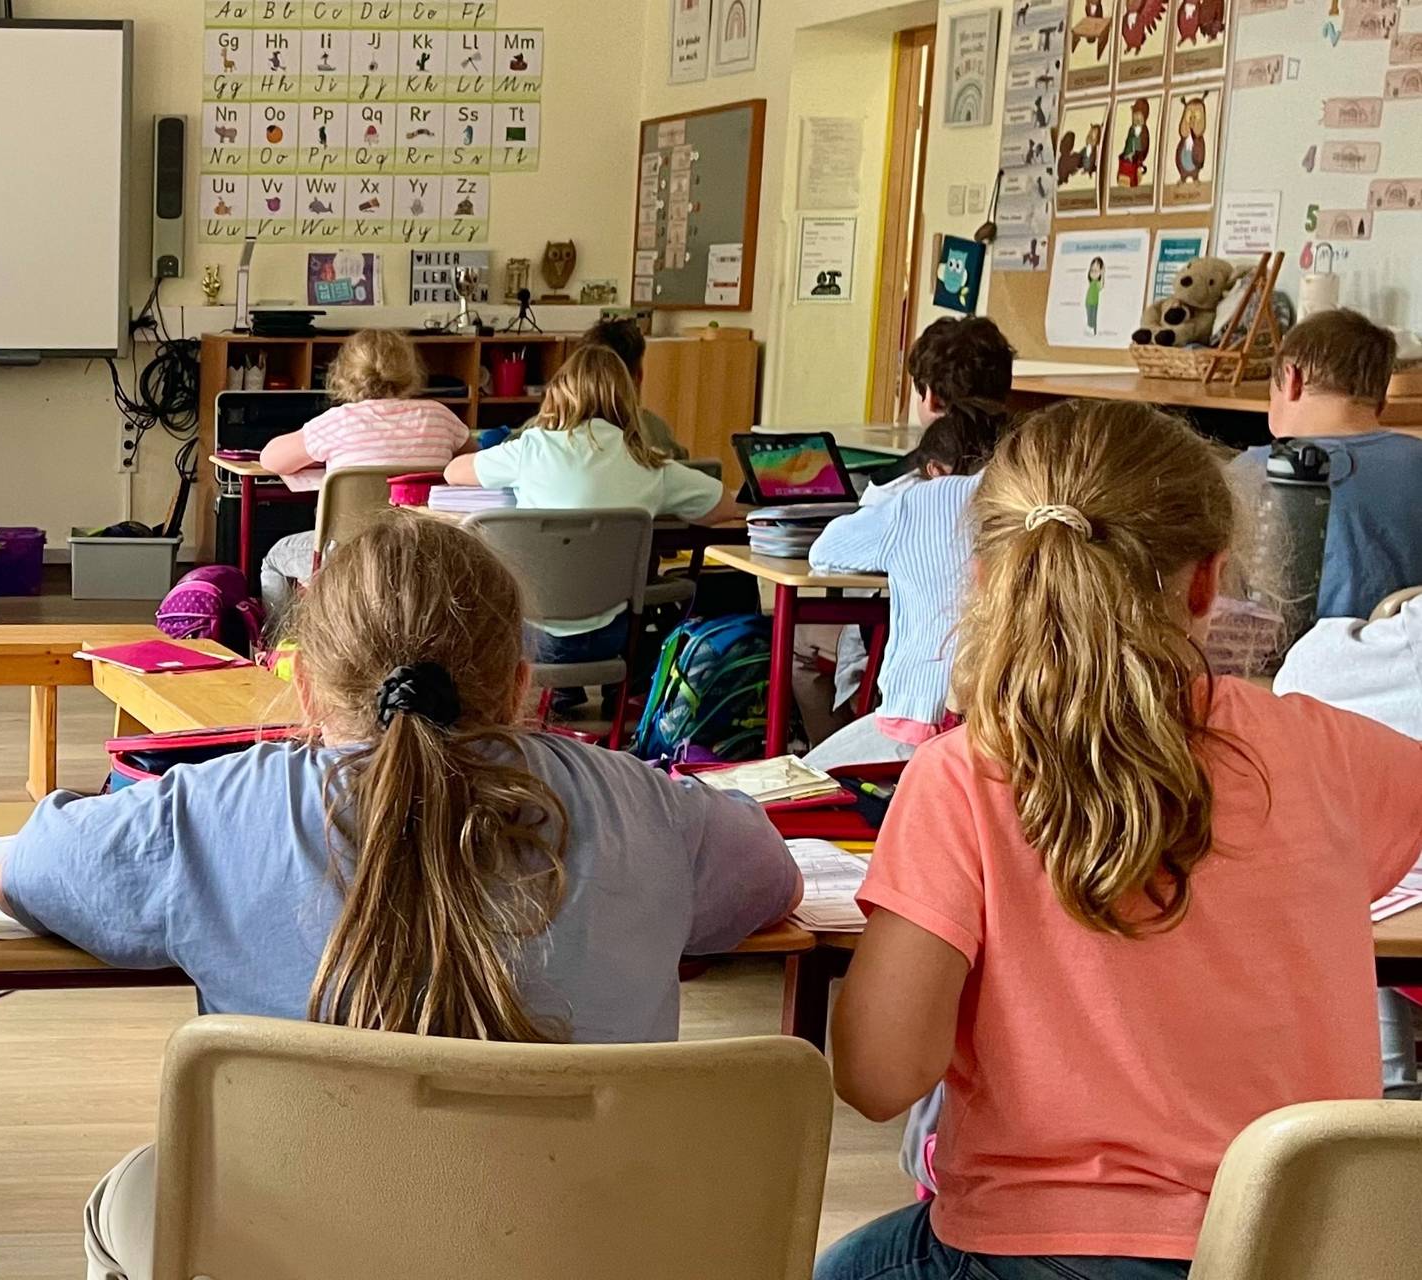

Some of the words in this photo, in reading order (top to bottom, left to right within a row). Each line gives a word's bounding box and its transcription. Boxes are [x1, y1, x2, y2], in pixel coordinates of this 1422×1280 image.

[218, 33, 239, 51] Gg
[266, 33, 288, 49] Hh
[321, 33, 332, 49] Ii
[367, 33, 381, 49] Jj
[413, 34, 433, 49] Kk
[463, 34, 479, 50] Ll
[504, 34, 535, 49] Mm
[215, 106, 237, 121] Nn
[264, 106, 285, 121] Oo
[313, 106, 334, 124] Pp
[362, 106, 382, 125] Qq
[410, 106, 431, 122] Rr
[458, 107, 479, 122] Ss
[509, 107, 525, 122] Tt
[212, 178, 235, 193] Uu
[261, 178, 283, 193] Vv
[306, 178, 337, 193] Ww
[360, 178, 380, 194] Xx
[409, 178, 428, 197] Yy
[456, 178, 477, 194] Zz
[1305, 204, 1319, 232] 5
[425, 252, 460, 265] HIER
[414, 289, 438, 302] DIE
